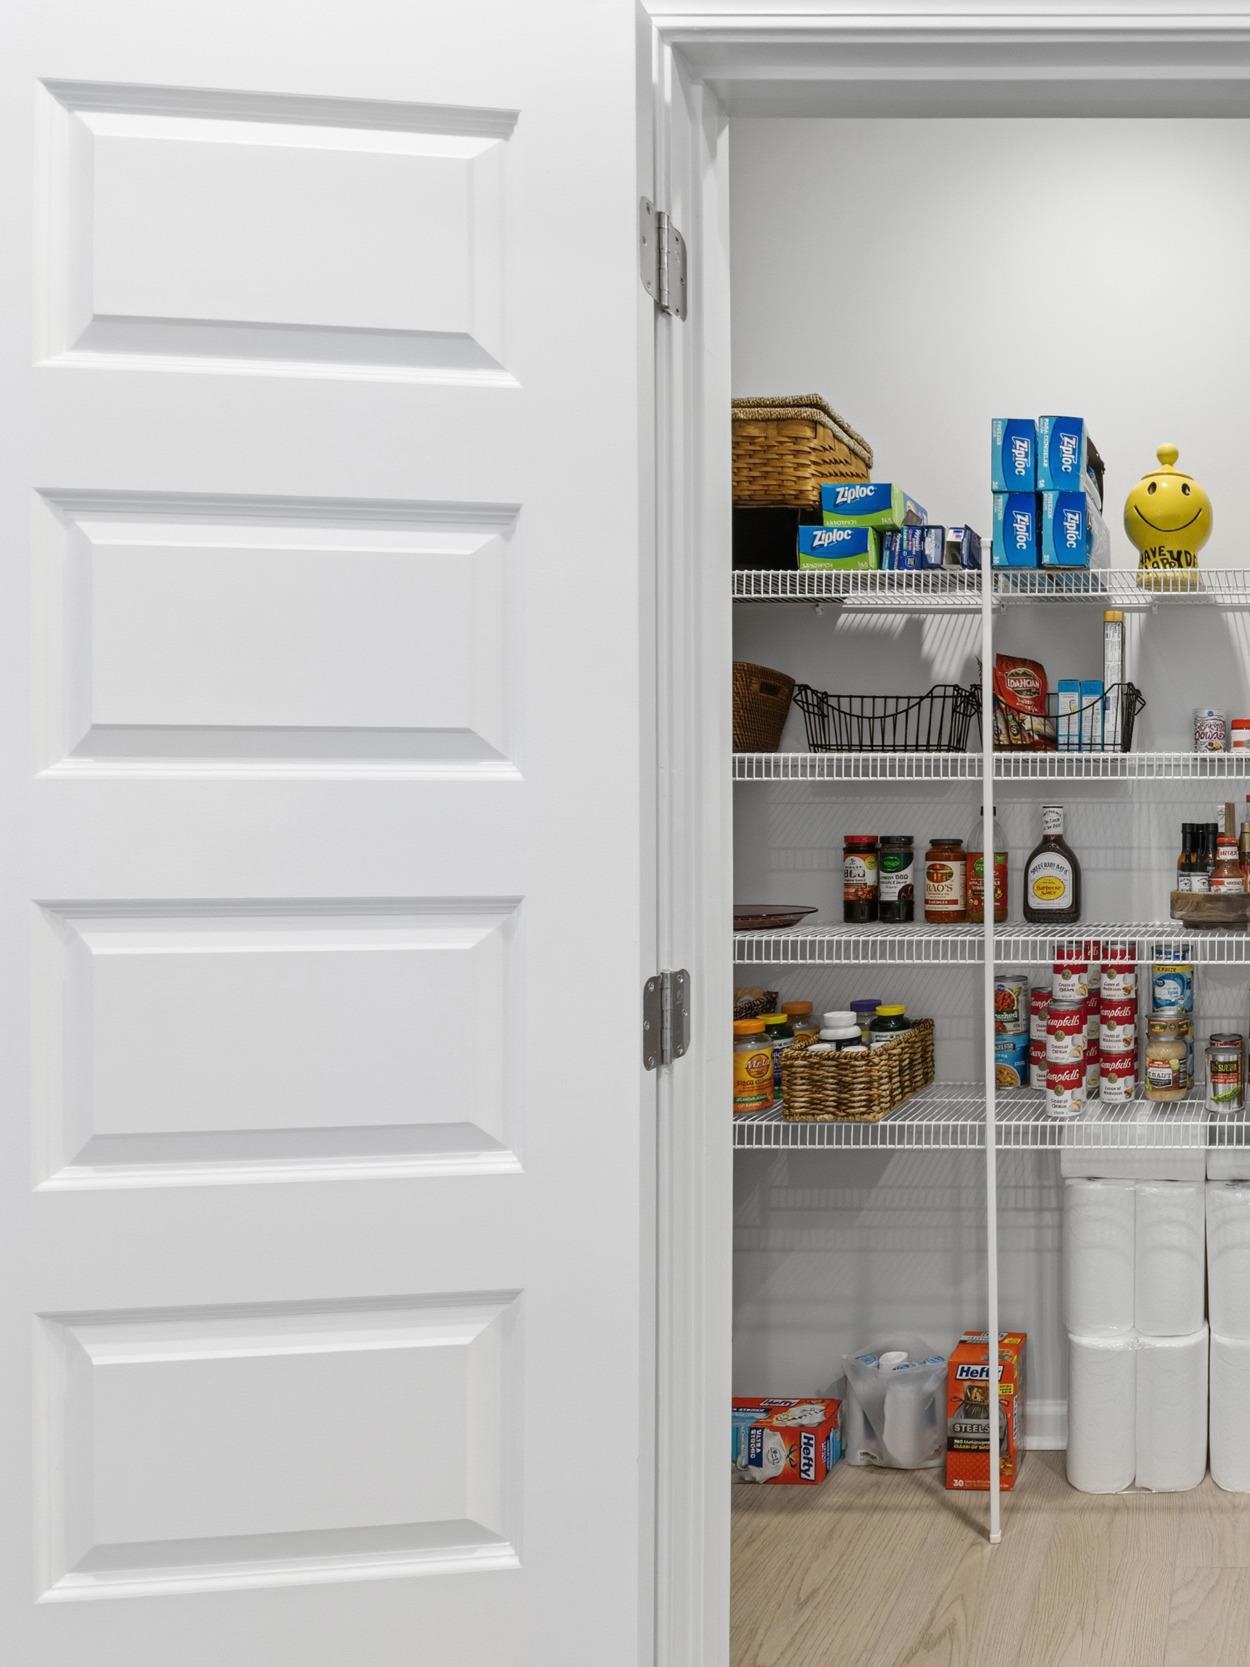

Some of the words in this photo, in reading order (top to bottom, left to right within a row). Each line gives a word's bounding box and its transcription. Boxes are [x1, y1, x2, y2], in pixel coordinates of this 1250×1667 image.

[1011, 438, 1028, 476] Ziploc
[1059, 434, 1076, 473] Ziploc
[836, 485, 875, 505] Ziploc
[812, 528, 853, 548] Ziploc
[1012, 513, 1029, 550] Ziploc
[1063, 512, 1079, 549] Ziploc
[800, 1434, 814, 1478] Hefty
